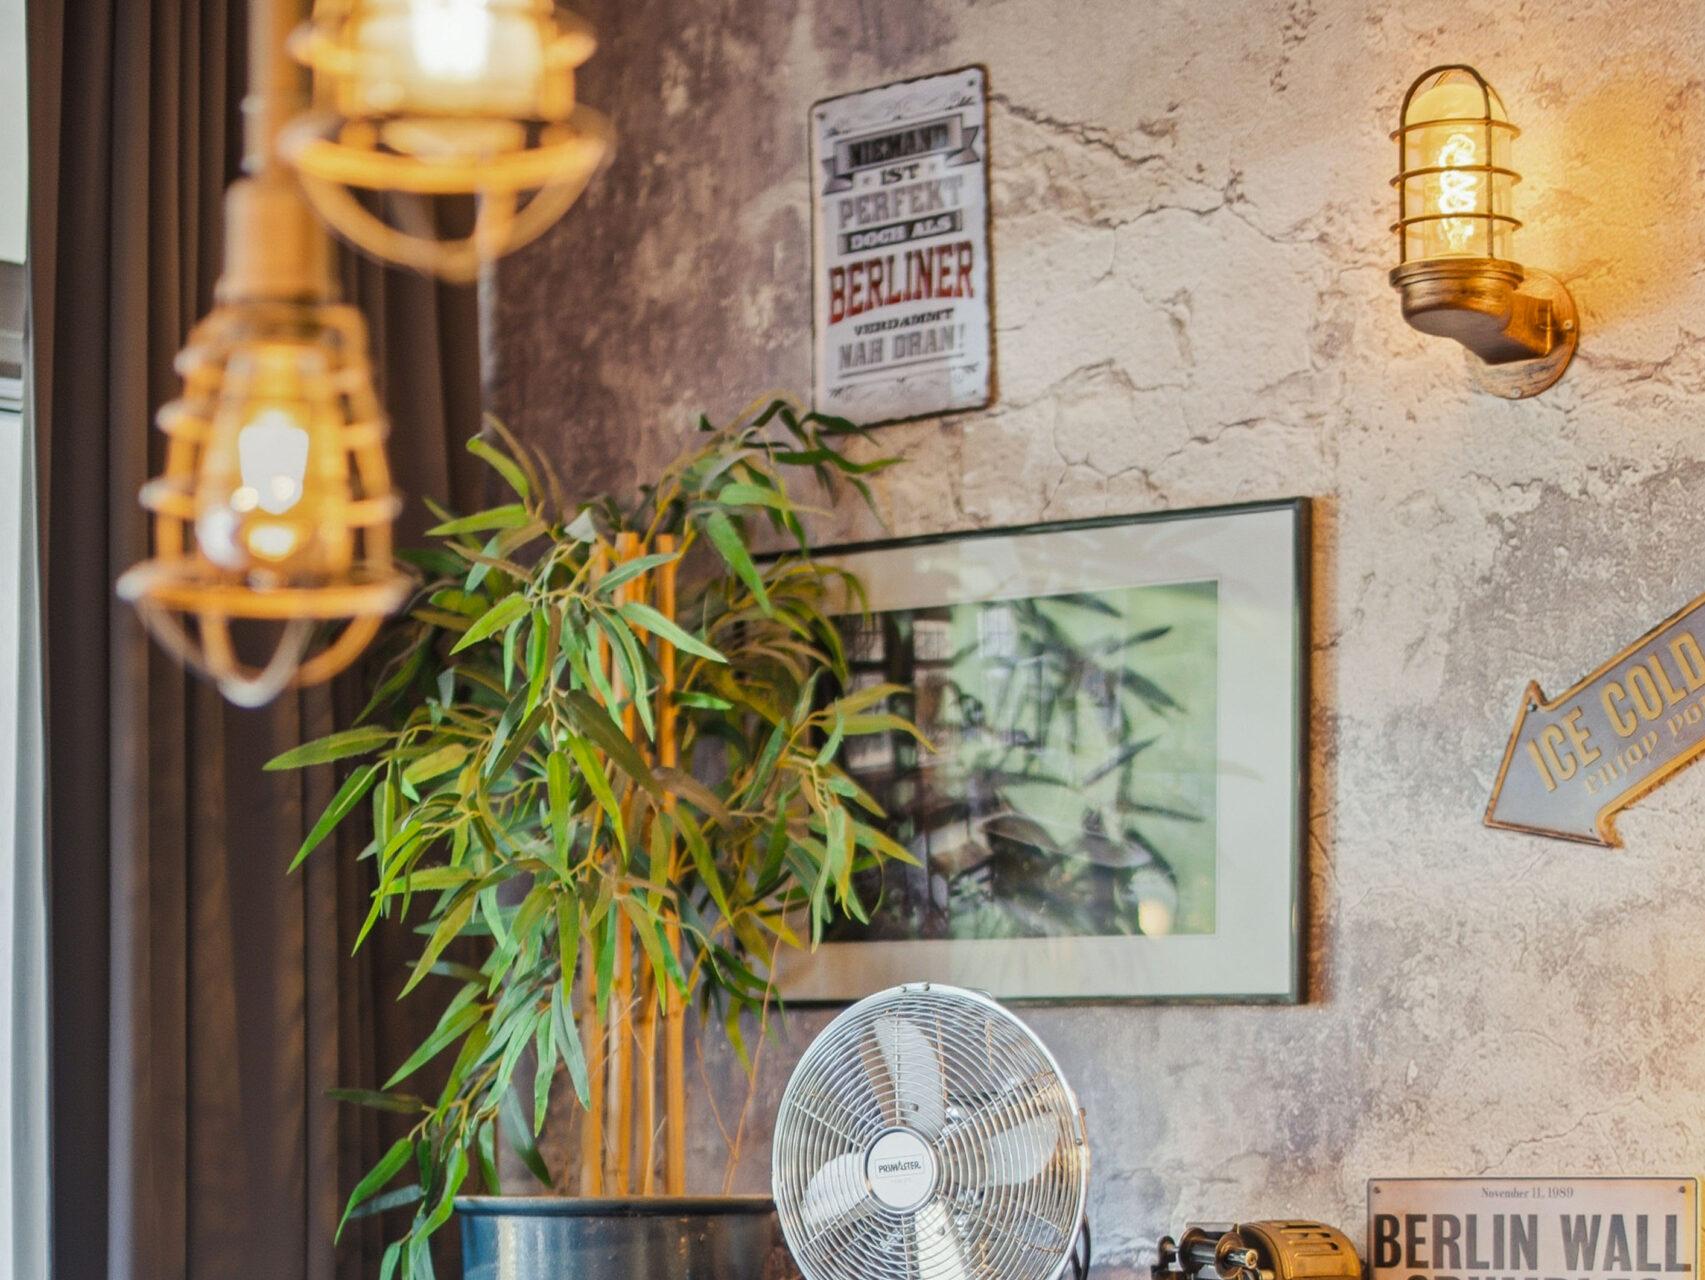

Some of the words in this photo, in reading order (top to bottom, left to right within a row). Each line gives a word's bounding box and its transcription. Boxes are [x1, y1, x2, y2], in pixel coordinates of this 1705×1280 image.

[880, 163, 920, 186] IST
[838, 174, 963, 229] PERFEKT
[850, 224, 907, 250] DOCH
[910, 215, 953, 238] ALS
[829, 240, 974, 325] BERLINER
[838, 336, 884, 370] NAH
[892, 322, 966, 360] DRAN!
[1526, 706, 1602, 793] ICE
[1601, 631, 1705, 738] COLD
[1666, 695, 1705, 745] yo
[1481, 1186, 1529, 1199] November
[1548, 1186, 1575, 1199] 1989
[1373, 1213, 1539, 1271] BERLIN
[1559, 1213, 1692, 1272] WALL
